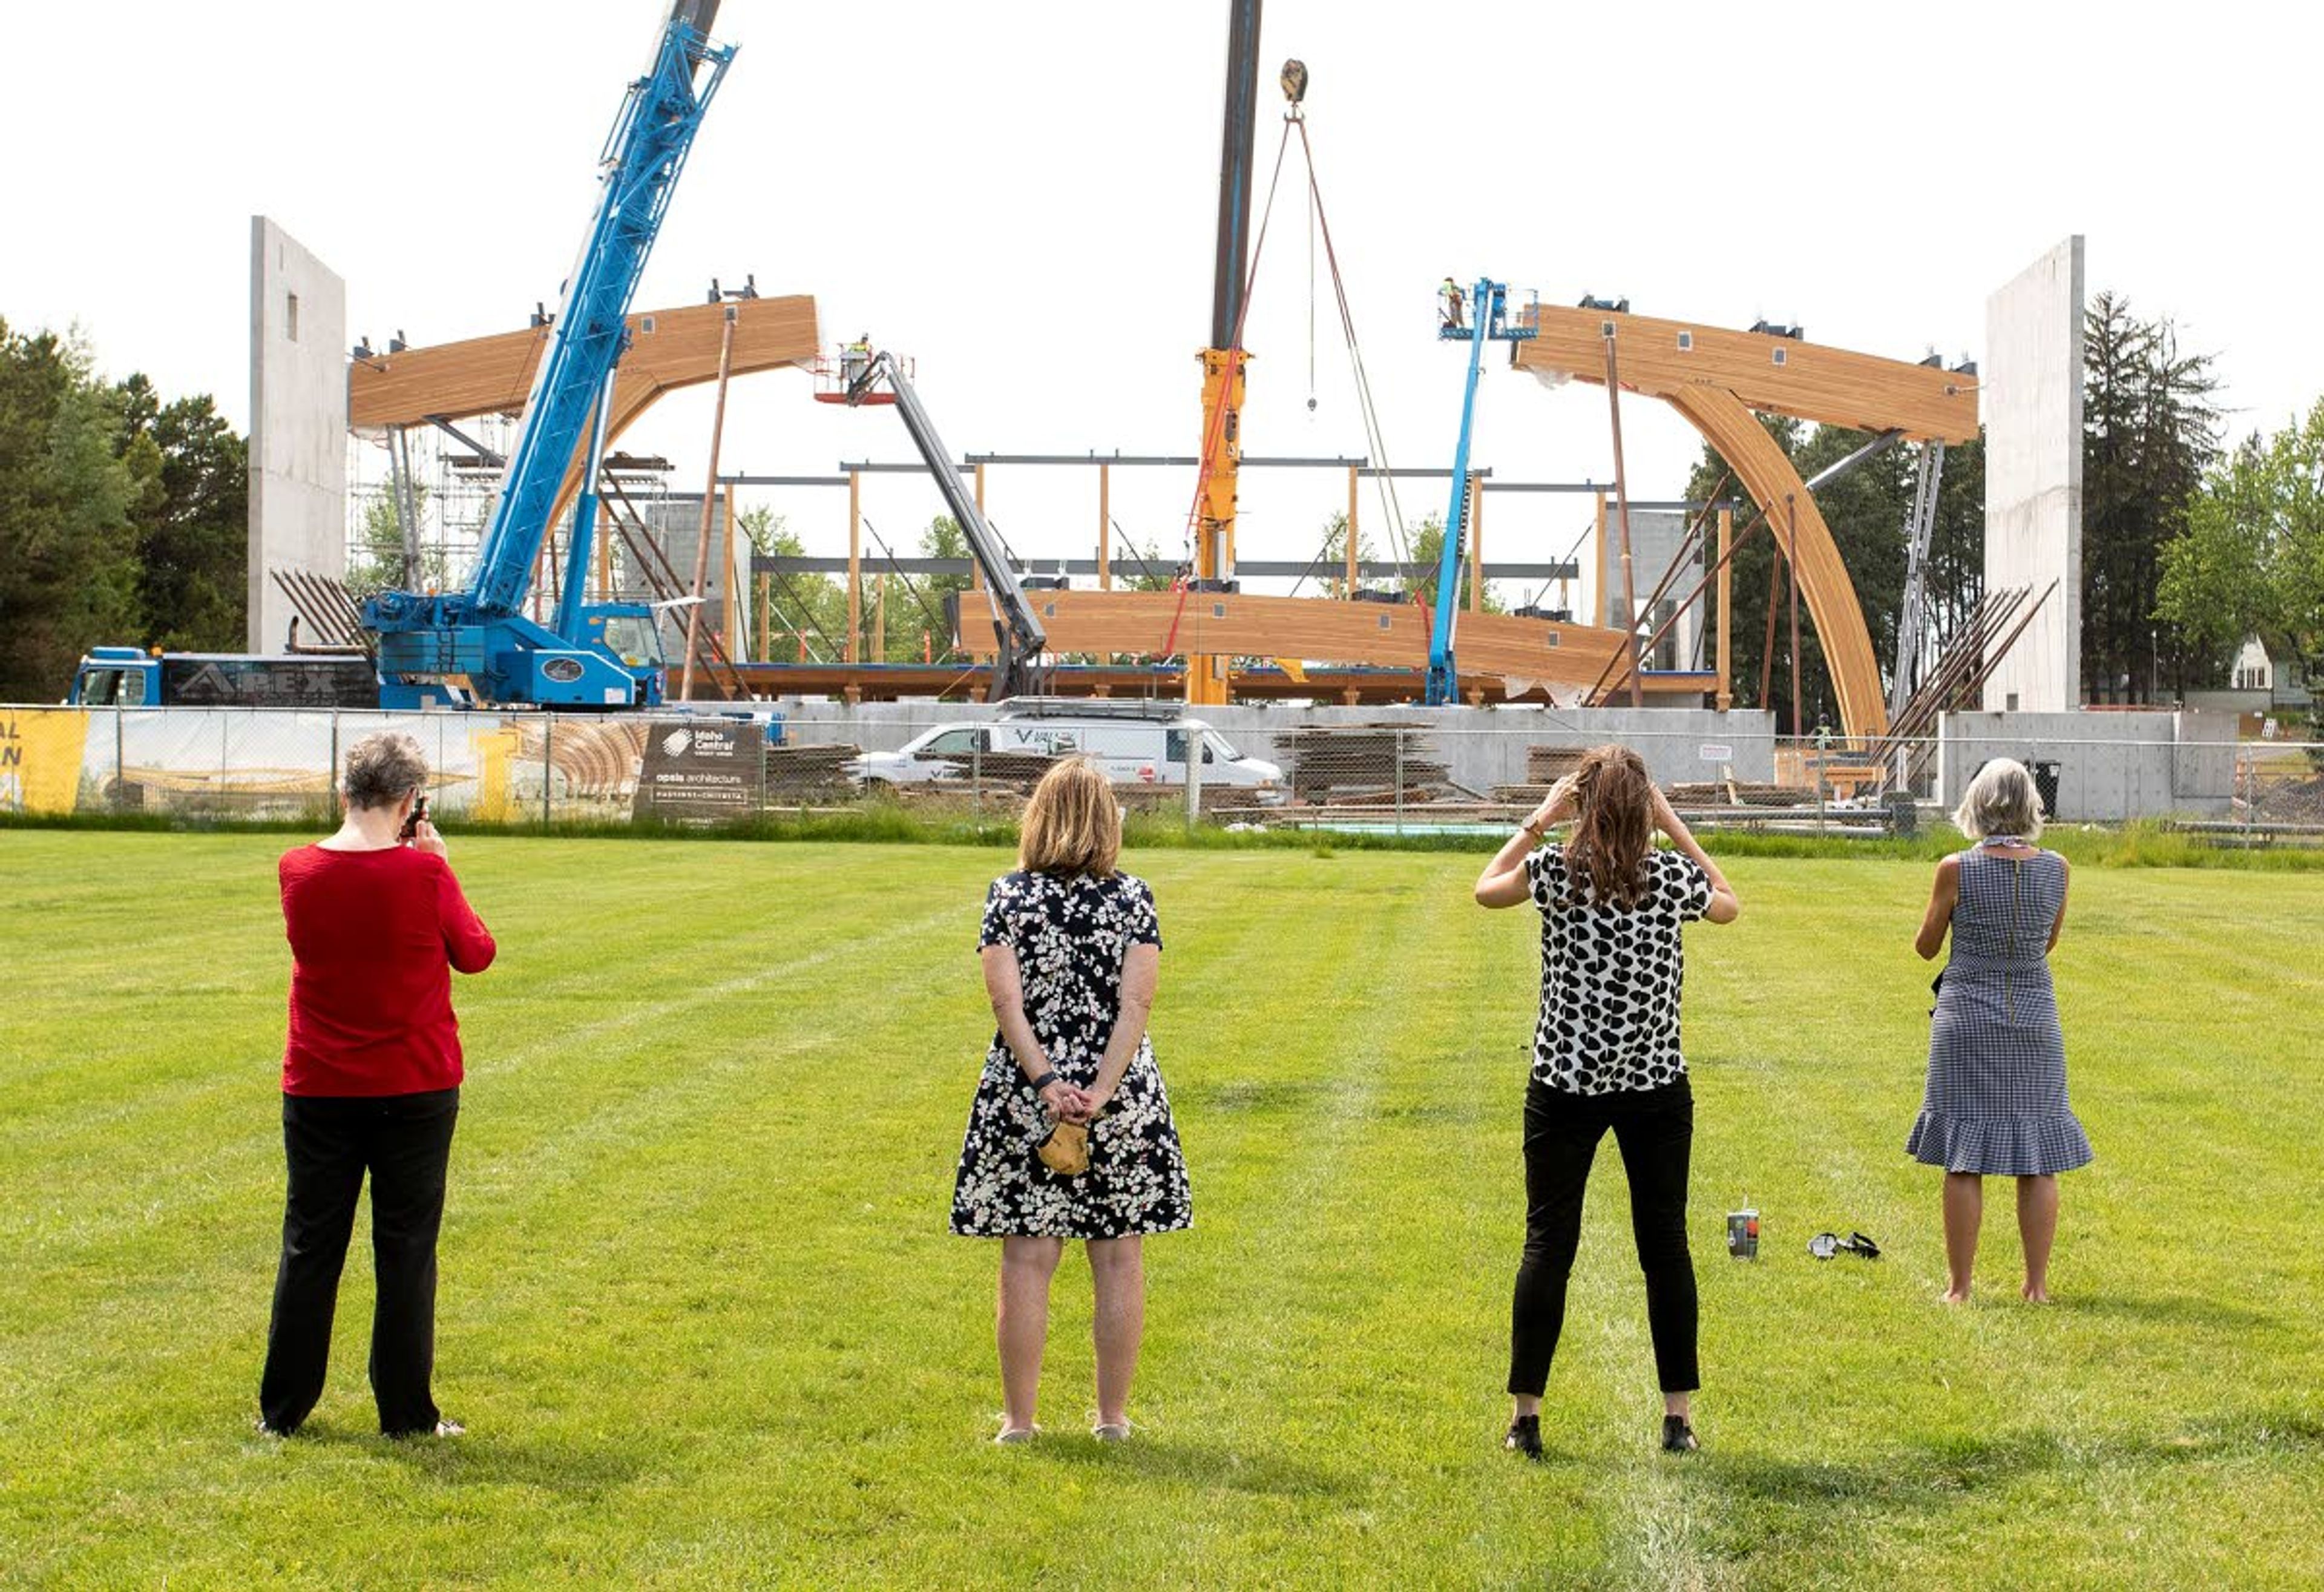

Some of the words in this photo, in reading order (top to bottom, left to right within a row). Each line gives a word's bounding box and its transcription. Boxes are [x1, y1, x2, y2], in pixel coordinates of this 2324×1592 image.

[179, 663, 335, 692] APEX
[695, 730, 723, 741] Idaho
[695, 740, 735, 751] Central
[686, 773, 742, 784] architecture
